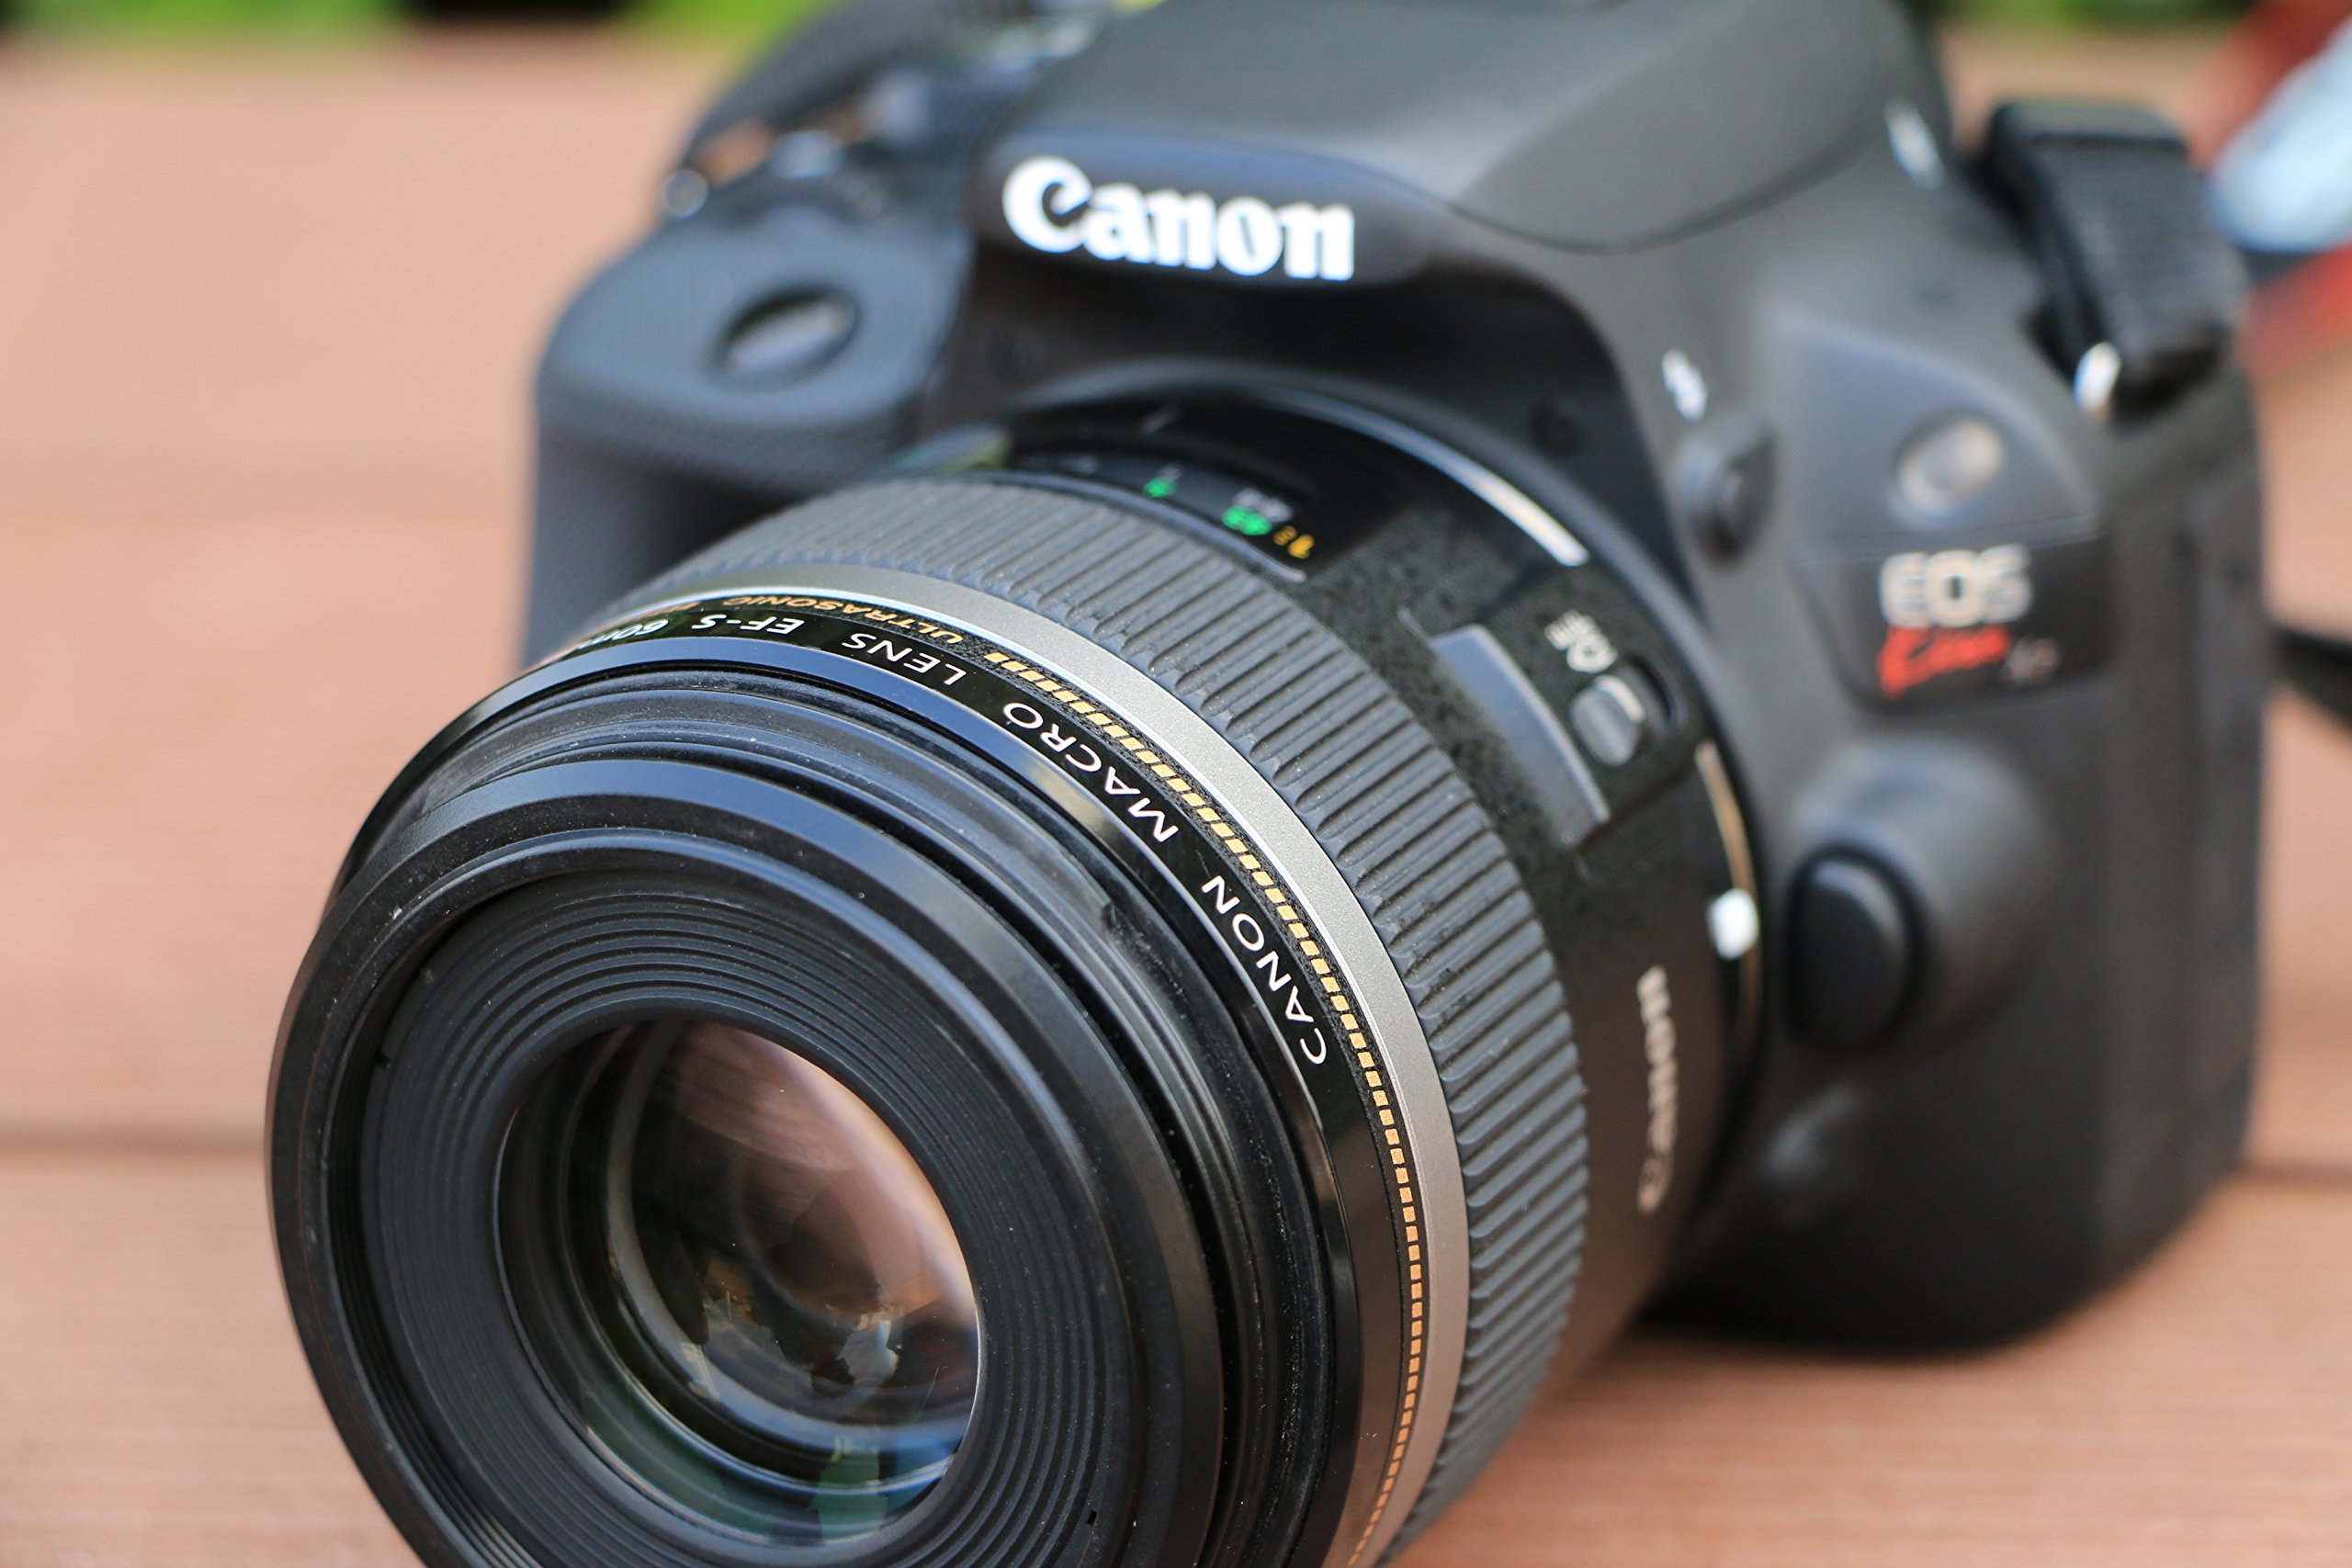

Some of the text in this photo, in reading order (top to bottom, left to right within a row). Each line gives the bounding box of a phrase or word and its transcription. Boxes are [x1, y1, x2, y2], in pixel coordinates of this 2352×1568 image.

[1002, 155, 1354, 281] Canon
[691, 614, 805, 635] EF-S
[722, 595, 964, 644] ULTRASONIC
[1879, 544, 2033, 628] EOS
[842, 633, 967, 686] LENS
[1002, 702, 1180, 842] MACRO
[1201, 874, 1327, 1066] CANON
